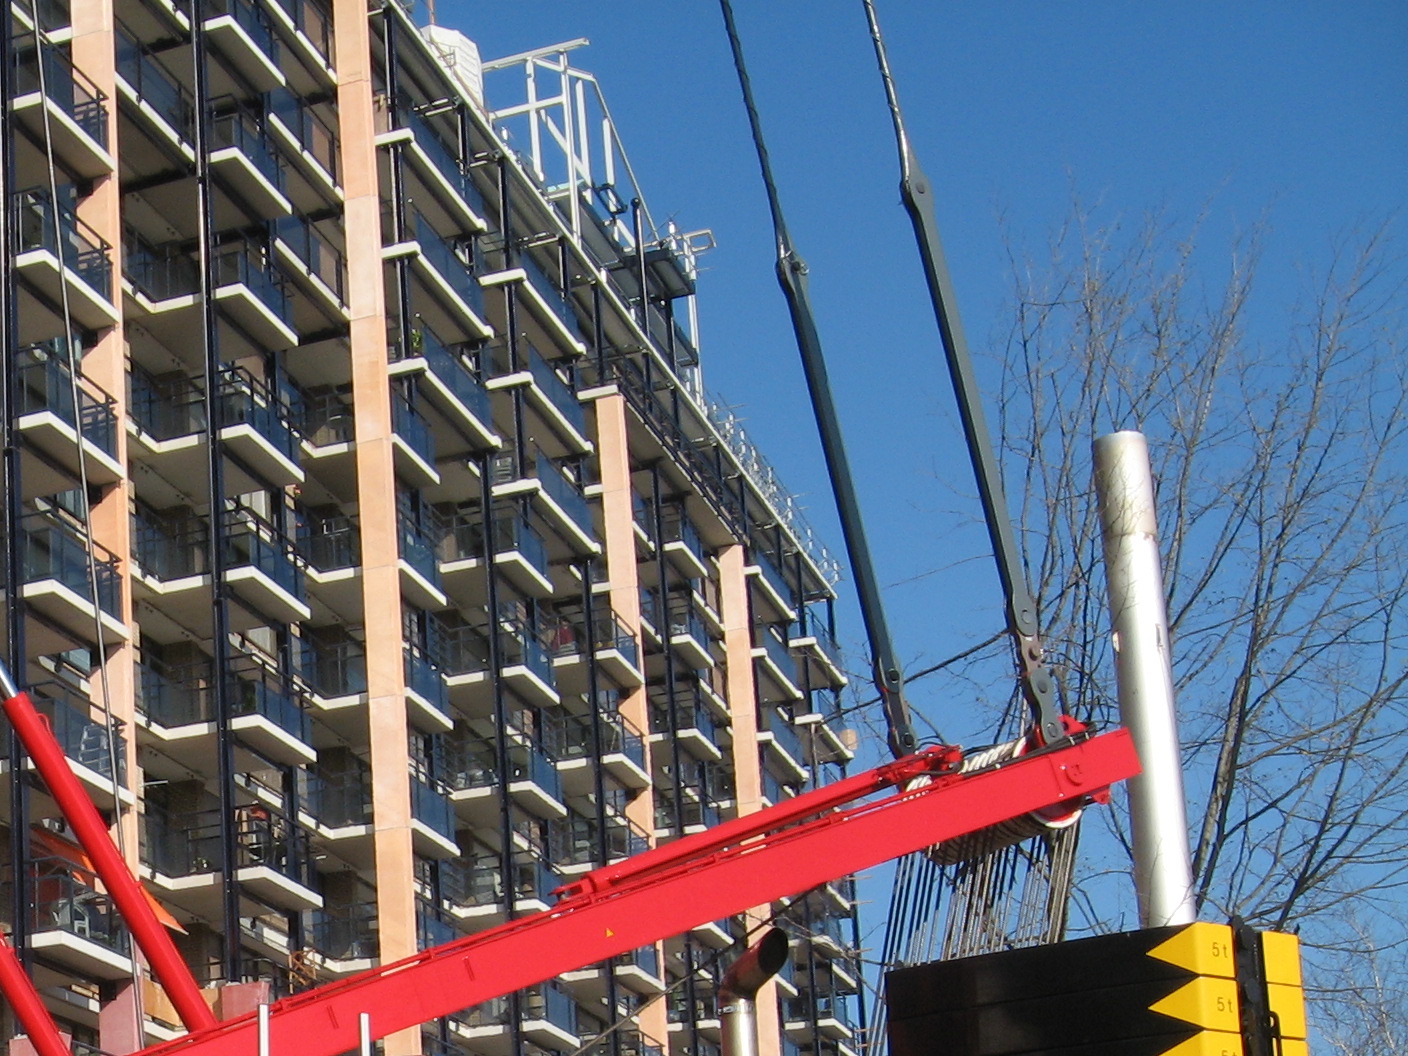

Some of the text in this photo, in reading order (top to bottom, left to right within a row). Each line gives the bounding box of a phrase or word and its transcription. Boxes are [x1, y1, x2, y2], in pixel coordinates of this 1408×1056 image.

[1212, 942, 1228, 958] 5 t
[1217, 997, 1233, 1013] 5 t
